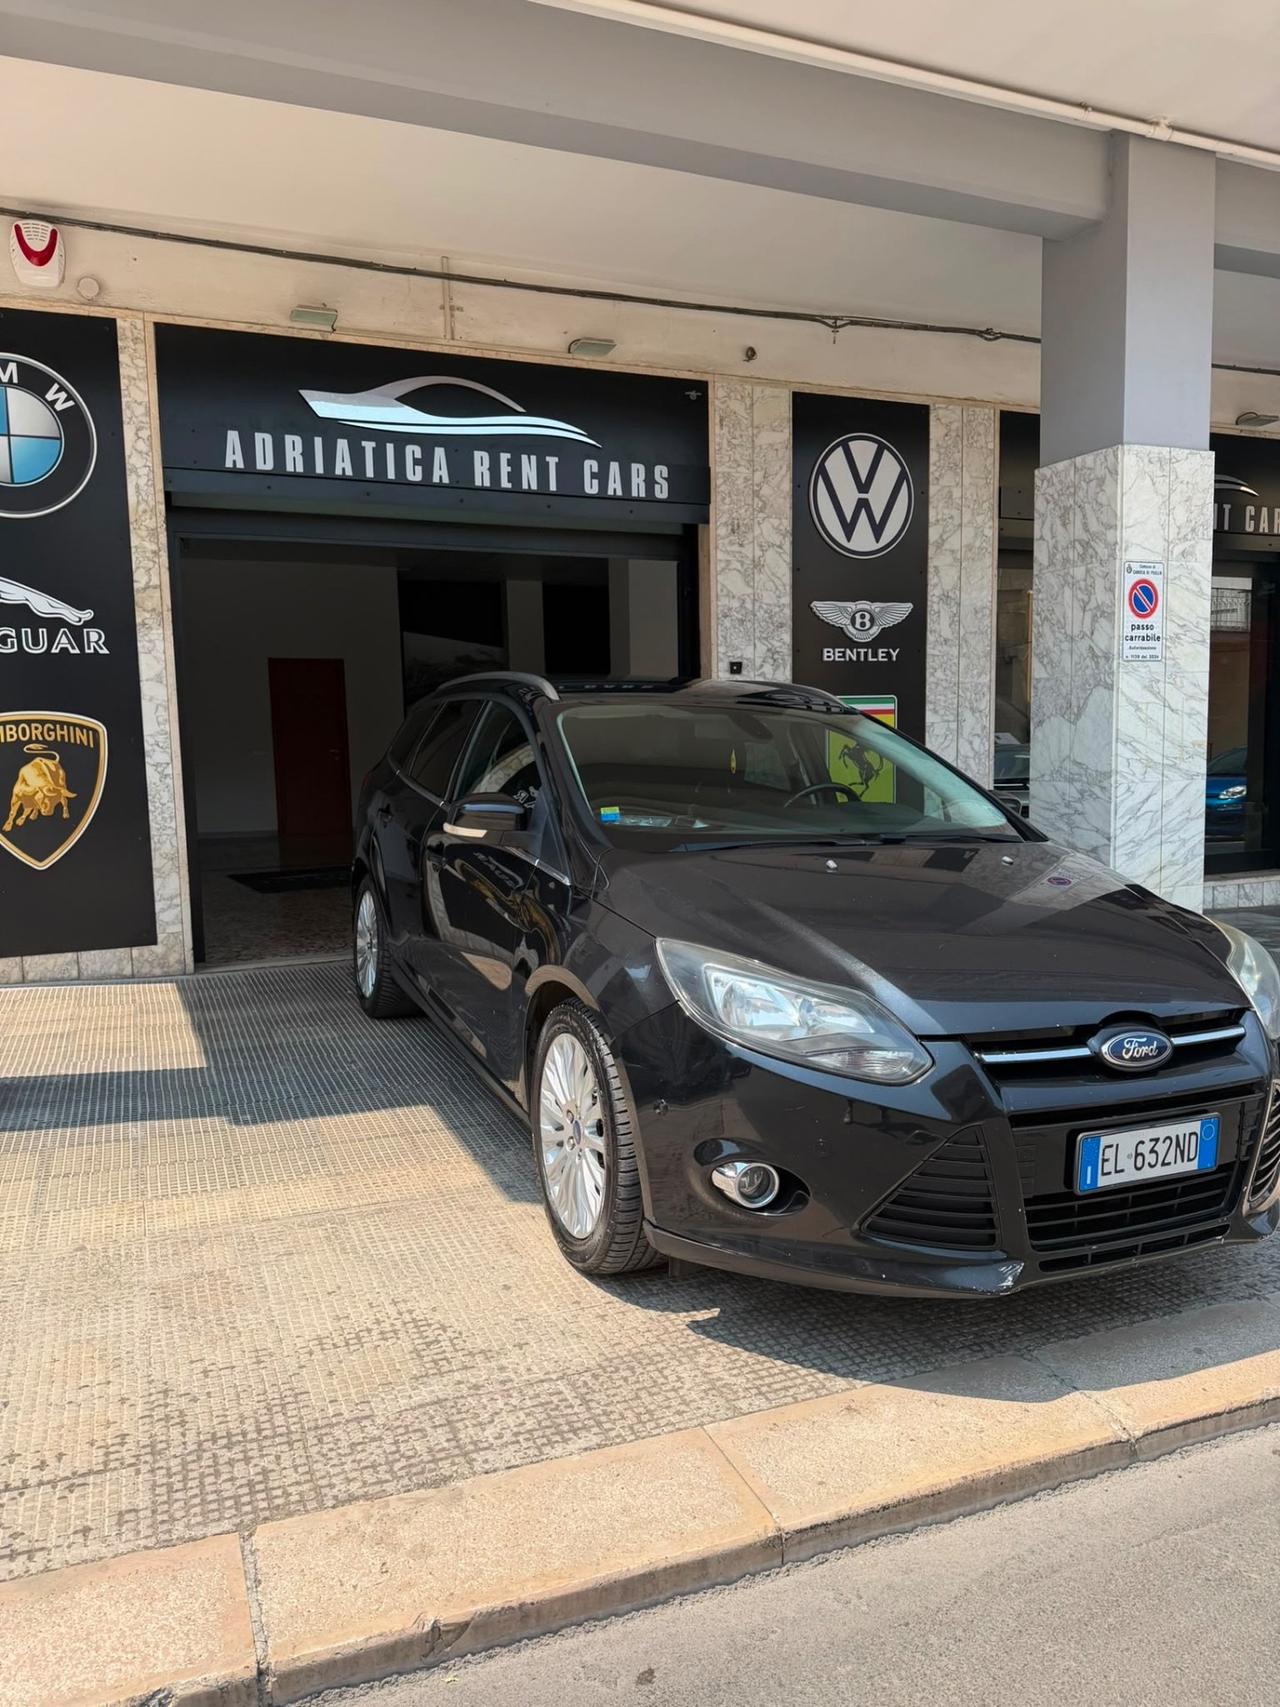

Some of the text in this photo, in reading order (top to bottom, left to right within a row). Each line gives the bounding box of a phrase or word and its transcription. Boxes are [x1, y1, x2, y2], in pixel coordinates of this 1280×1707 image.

[224, 429, 669, 499] ADRIATICA RENT CARS
[1124, 633, 1161, 641] carrabile
[1131, 624, 1154, 632] passo
[822, 648, 900, 662] BENTLEY
[1122, 1037, 1159, 1059] Ford
[1101, 1143, 1125, 1177] EL
[1133, 1131, 1199, 1171] 632ND
